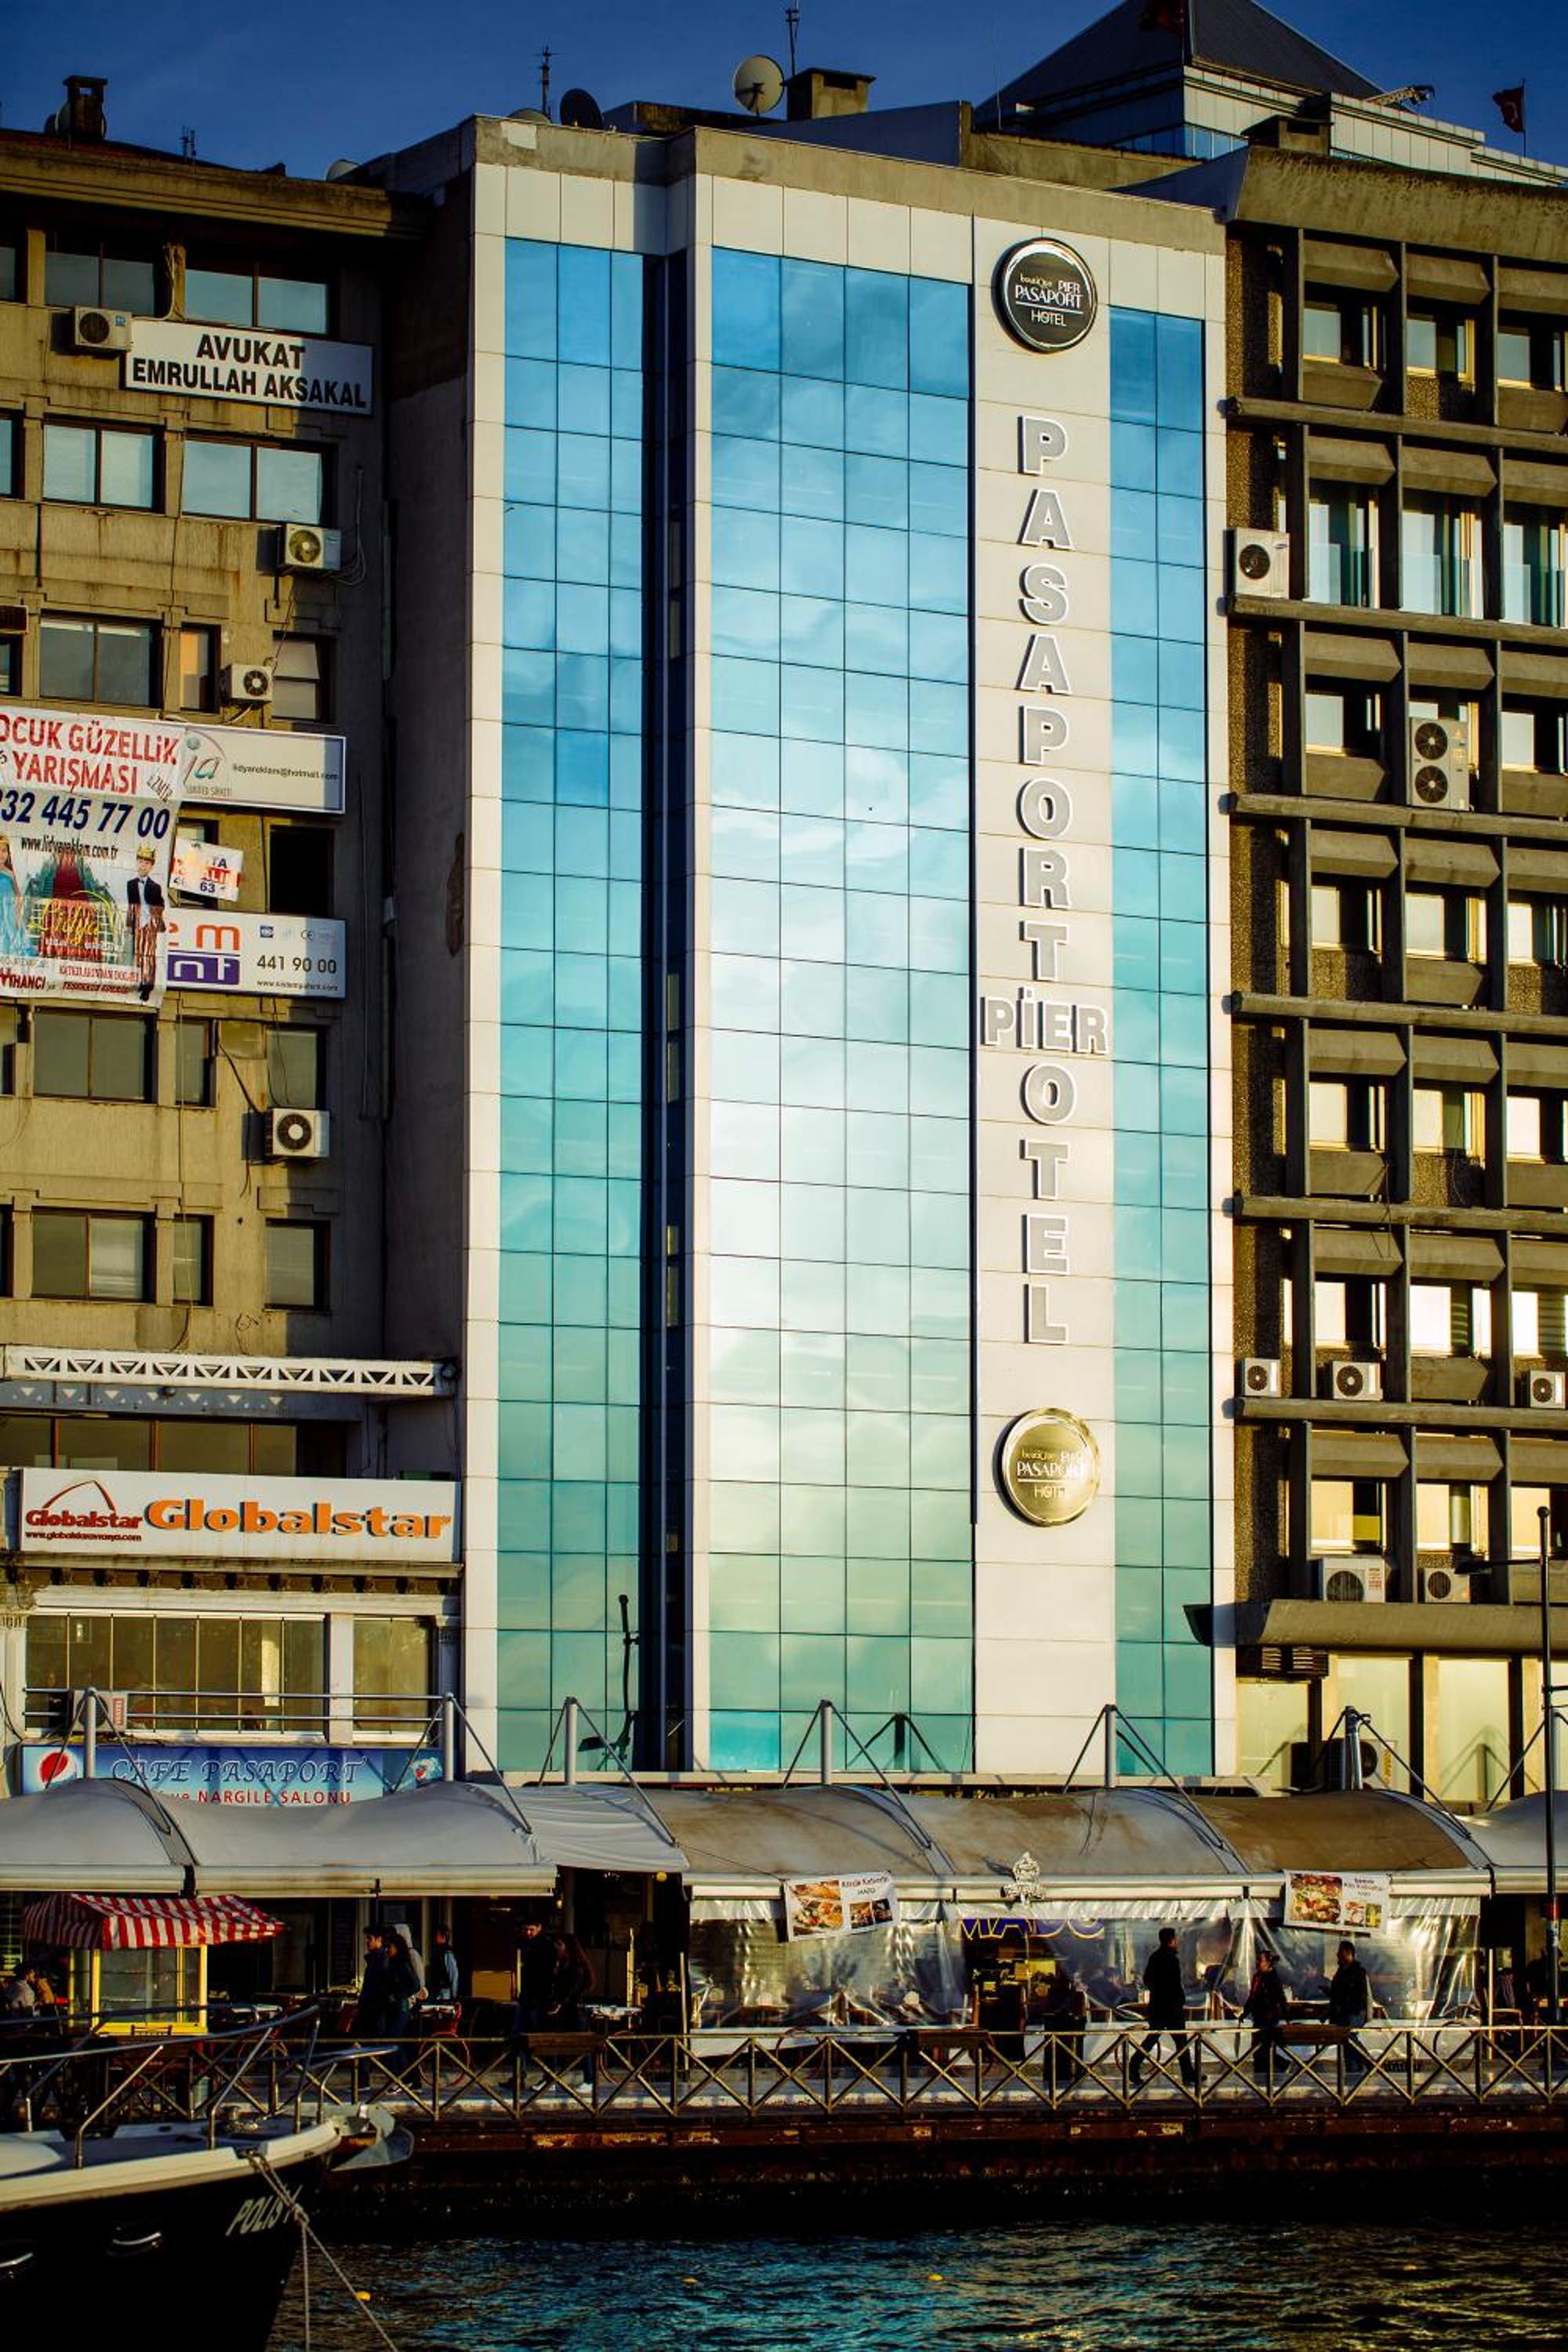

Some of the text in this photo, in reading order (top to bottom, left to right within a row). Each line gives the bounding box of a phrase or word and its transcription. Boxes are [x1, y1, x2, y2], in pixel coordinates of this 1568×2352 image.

[1015, 285, 1083, 308] PASAPORT
[1058, 280, 1080, 294] PIER
[1031, 310, 1066, 327] HOTEL
[197, 333, 306, 369] AVUKAT
[132, 358, 367, 408] EMRULLAH AKSAKAL
[1016, 415, 1074, 982] PASAPORT
[69, 720, 179, 765] GÜZELLİK
[13, 750, 137, 794] YARIŞMASI
[0, 789, 170, 839] 32 445 77 00
[257, 955, 336, 975] 441 90 00
[1020, 1062, 1076, 1345] OTEL
[26, 1498, 452, 1538] Globalstar Globalstar
[111, 1755, 368, 1783] CAFE PASAPORT
[198, 1789, 270, 1804] NARGİLE
[281, 1791, 350, 1804] SALONU
